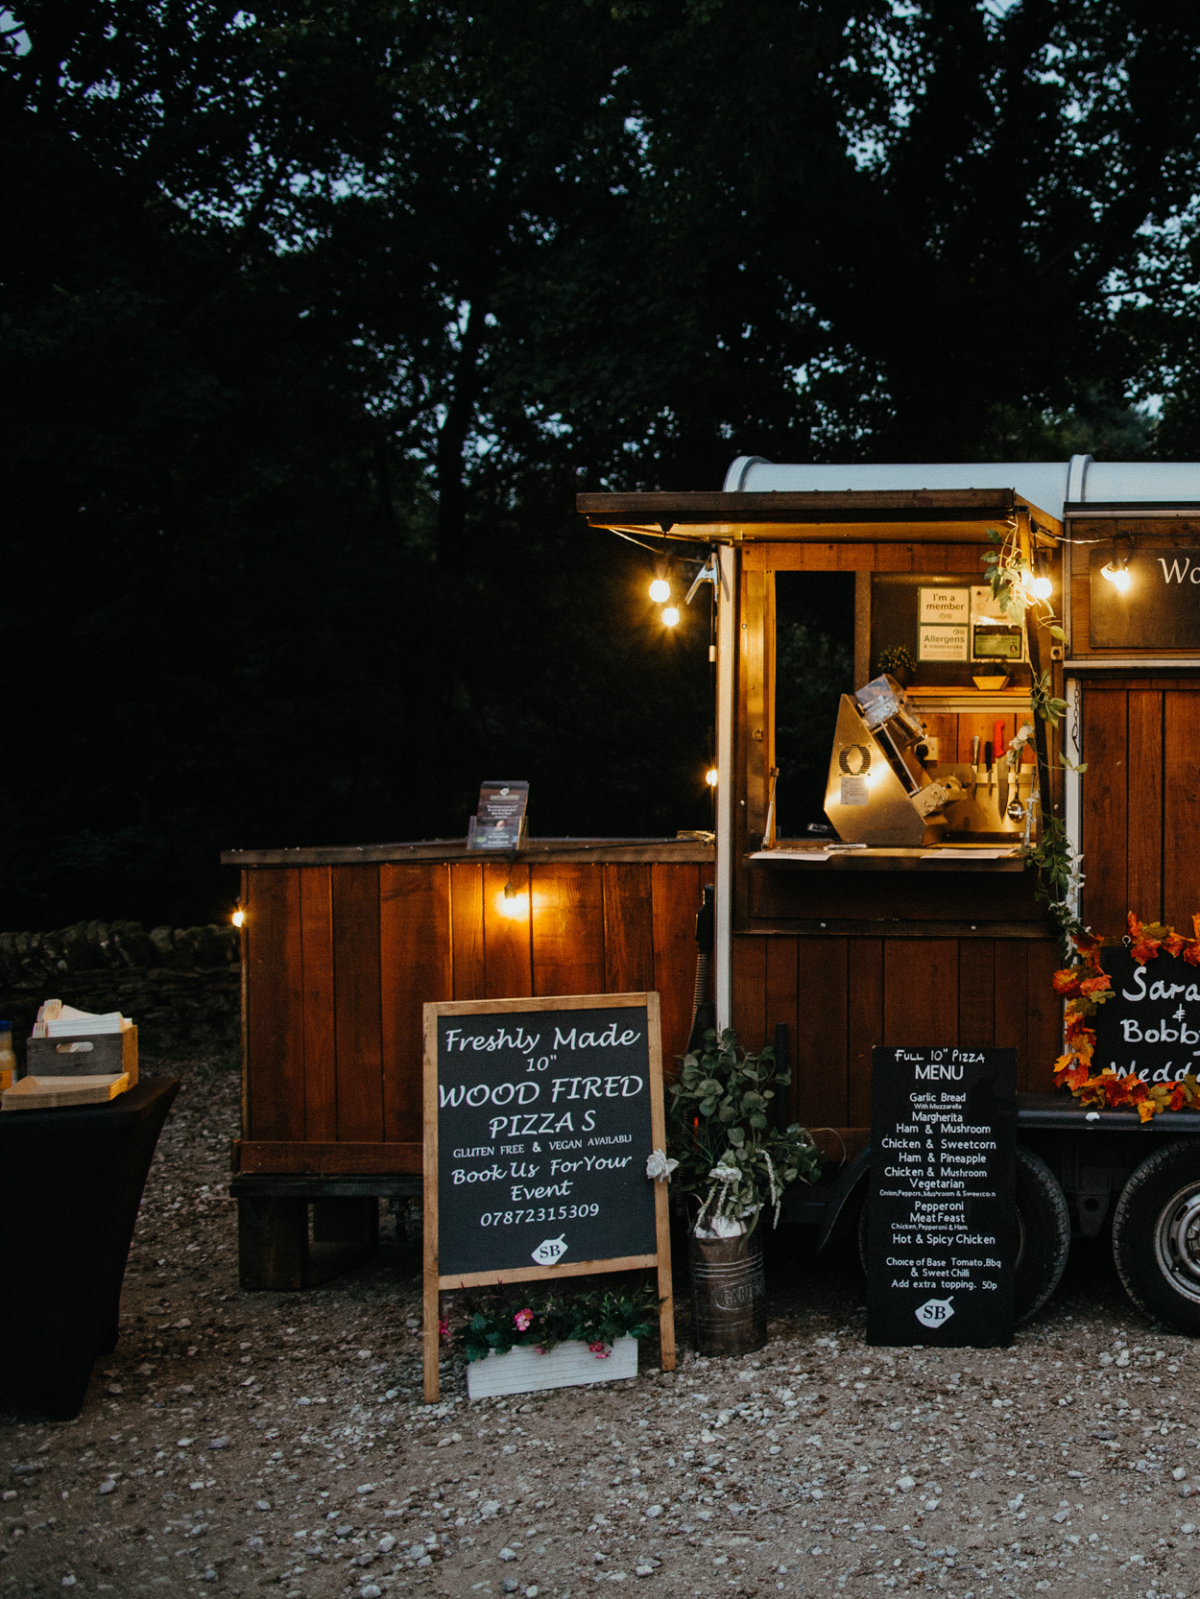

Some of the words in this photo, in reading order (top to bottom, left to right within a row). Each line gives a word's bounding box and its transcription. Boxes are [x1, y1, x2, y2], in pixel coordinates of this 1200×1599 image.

[933, 593, 947, 601] I'm
[926, 602, 964, 610] member
[924, 635, 965, 644] Allergens
[445, 1028, 540, 1053] Freshly
[554, 1023, 641, 1050] Made
[526, 1055, 557, 1072] 10"
[915, 1065, 964, 1080] MENU
[438, 1081, 540, 1108] WOOD
[551, 1074, 643, 1103] FIRED
[910, 1093, 936, 1102] Garlic
[941, 1093, 966, 1102] Bread
[912, 1112, 963, 1124] Margherita
[896, 1124, 919, 1133] Ham
[925, 1125, 933, 1134] &
[941, 1124, 991, 1134] Mushroom
[453, 1146, 495, 1159] GLUTEN
[500, 1143, 525, 1155] FREE
[532, 1141, 541, 1153] &
[549, 1139, 582, 1151] VEGAN
[882, 1138, 921, 1148] Chicken
[926, 1139, 934, 1148] &
[941, 1139, 997, 1149] Sweetcorn
[899, 1152, 921, 1162] Ham
[928, 1153, 935, 1162] &
[940, 1153, 986, 1165] Pineapple
[452, 1162, 508, 1185] Book
[510, 1161, 540, 1179] Us
[550, 1157, 583, 1178] For
[581, 1155, 633, 1172] Your
[884, 1167, 923, 1177] Chicken
[927, 1167, 934, 1177] &
[941, 1168, 987, 1177] Mushroom
[909, 1179, 964, 1190] Vegetarian
[510, 1180, 573, 1201] Event
[915, 1201, 964, 1212] Pepperoni
[480, 1203, 600, 1227] 07872315309
[910, 1213, 936, 1223] Meat
[938, 1213, 965, 1223] Feast
[893, 1234, 912, 1244] Hot
[916, 1234, 923, 1244] &
[927, 1235, 954, 1246] Spicy
[956, 1234, 995, 1245] Chicken
[538, 1244, 561, 1259] SB
[886, 1257, 914, 1266] Choice
[916, 1258, 925, 1266] of
[927, 1258, 946, 1266] Base
[911, 1268, 919, 1277] &
[923, 1269, 949, 1277] Sweet
[951, 1269, 970, 1277] Chilli
[891, 1280, 909, 1288] Add
[913, 1280, 936, 1288] extra
[982, 1281, 998, 1290] 50p
[923, 1305, 946, 1320] SB
